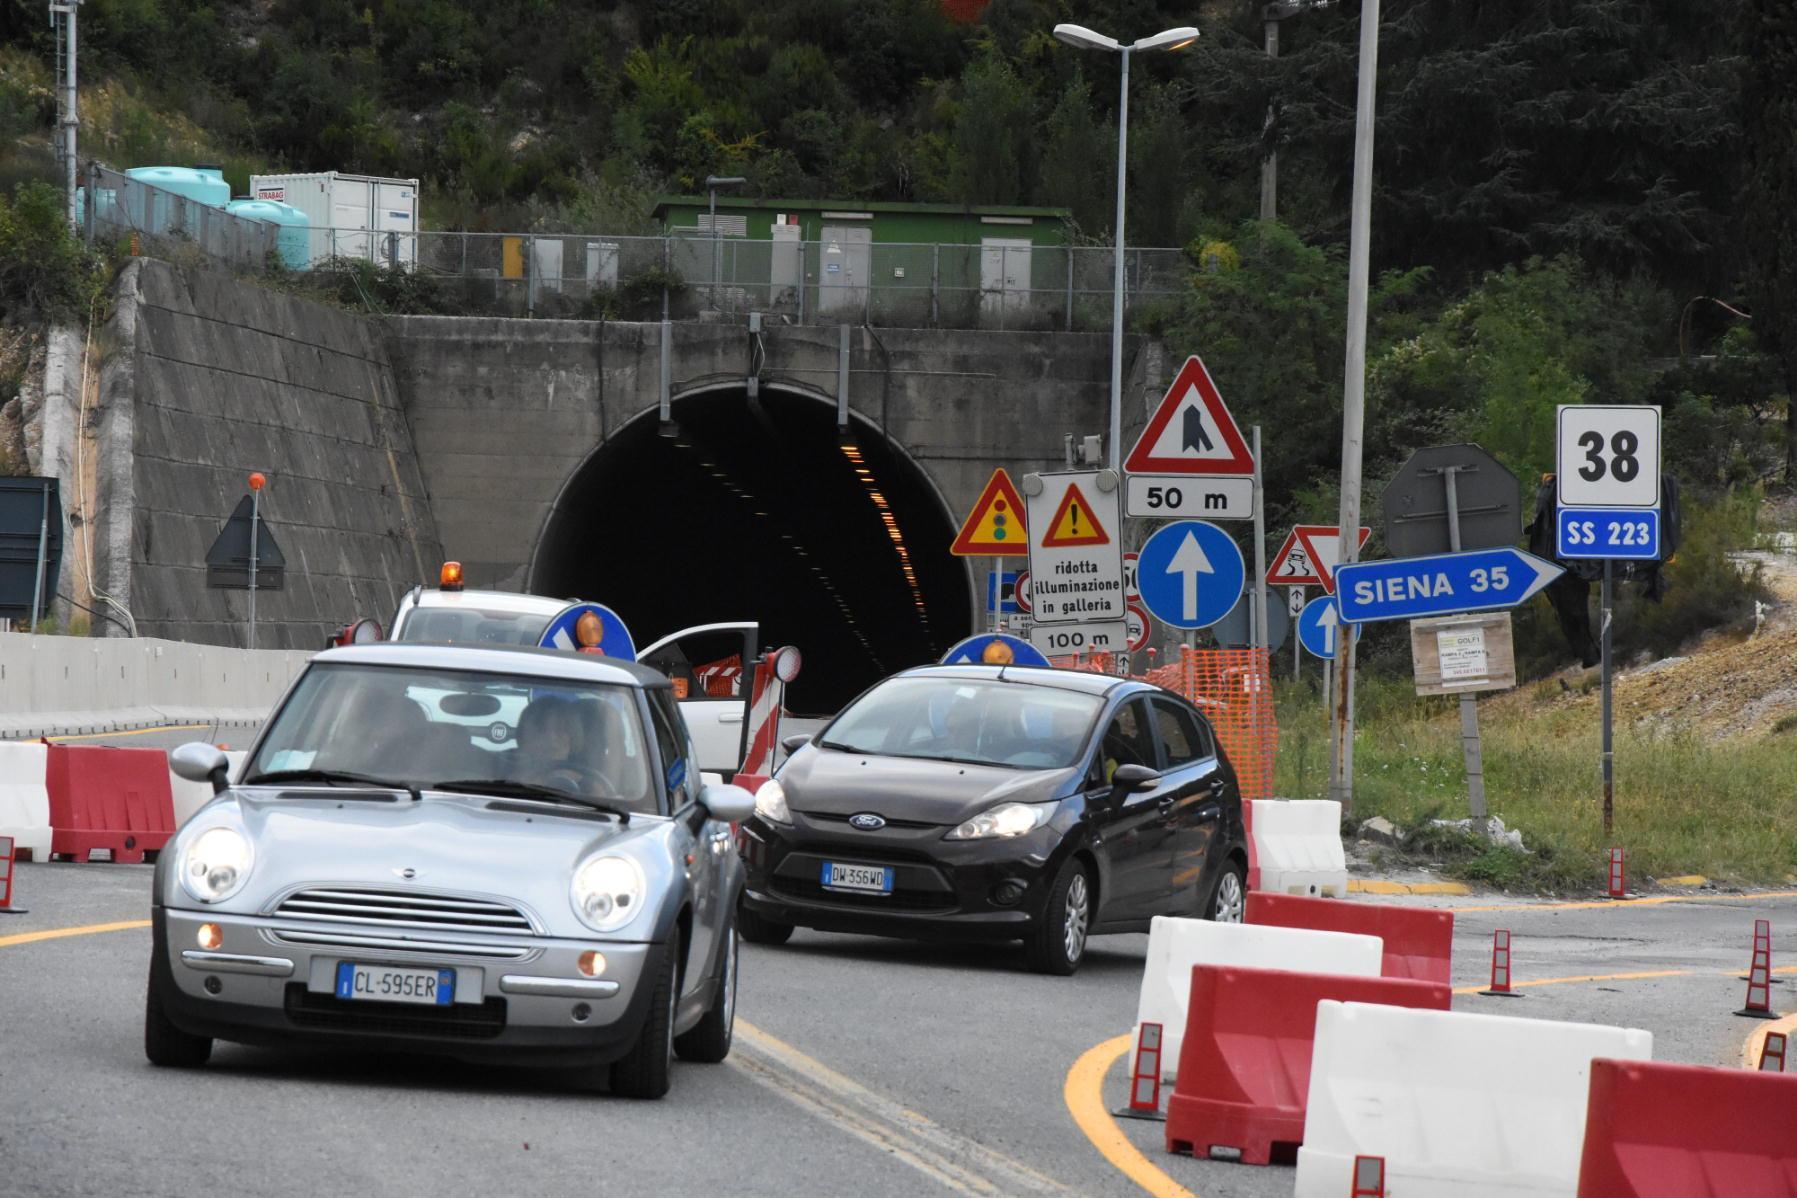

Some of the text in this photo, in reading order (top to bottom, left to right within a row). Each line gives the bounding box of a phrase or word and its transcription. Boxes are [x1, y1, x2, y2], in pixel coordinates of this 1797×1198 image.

[258, 191, 284, 200] STRABAG
[1577, 430, 1640, 482] 38
[1146, 487, 1228, 509] 50 m
[1567, 521, 1650, 545] SS 223
[1055, 560, 1098, 575] ridotta
[1035, 578, 1120, 595] illuminazione
[1354, 566, 1510, 606] SIENA 35
[1043, 598, 1112, 615] in galleria
[1048, 632, 1109, 649] 100 m
[856, 815, 877, 826] Ford
